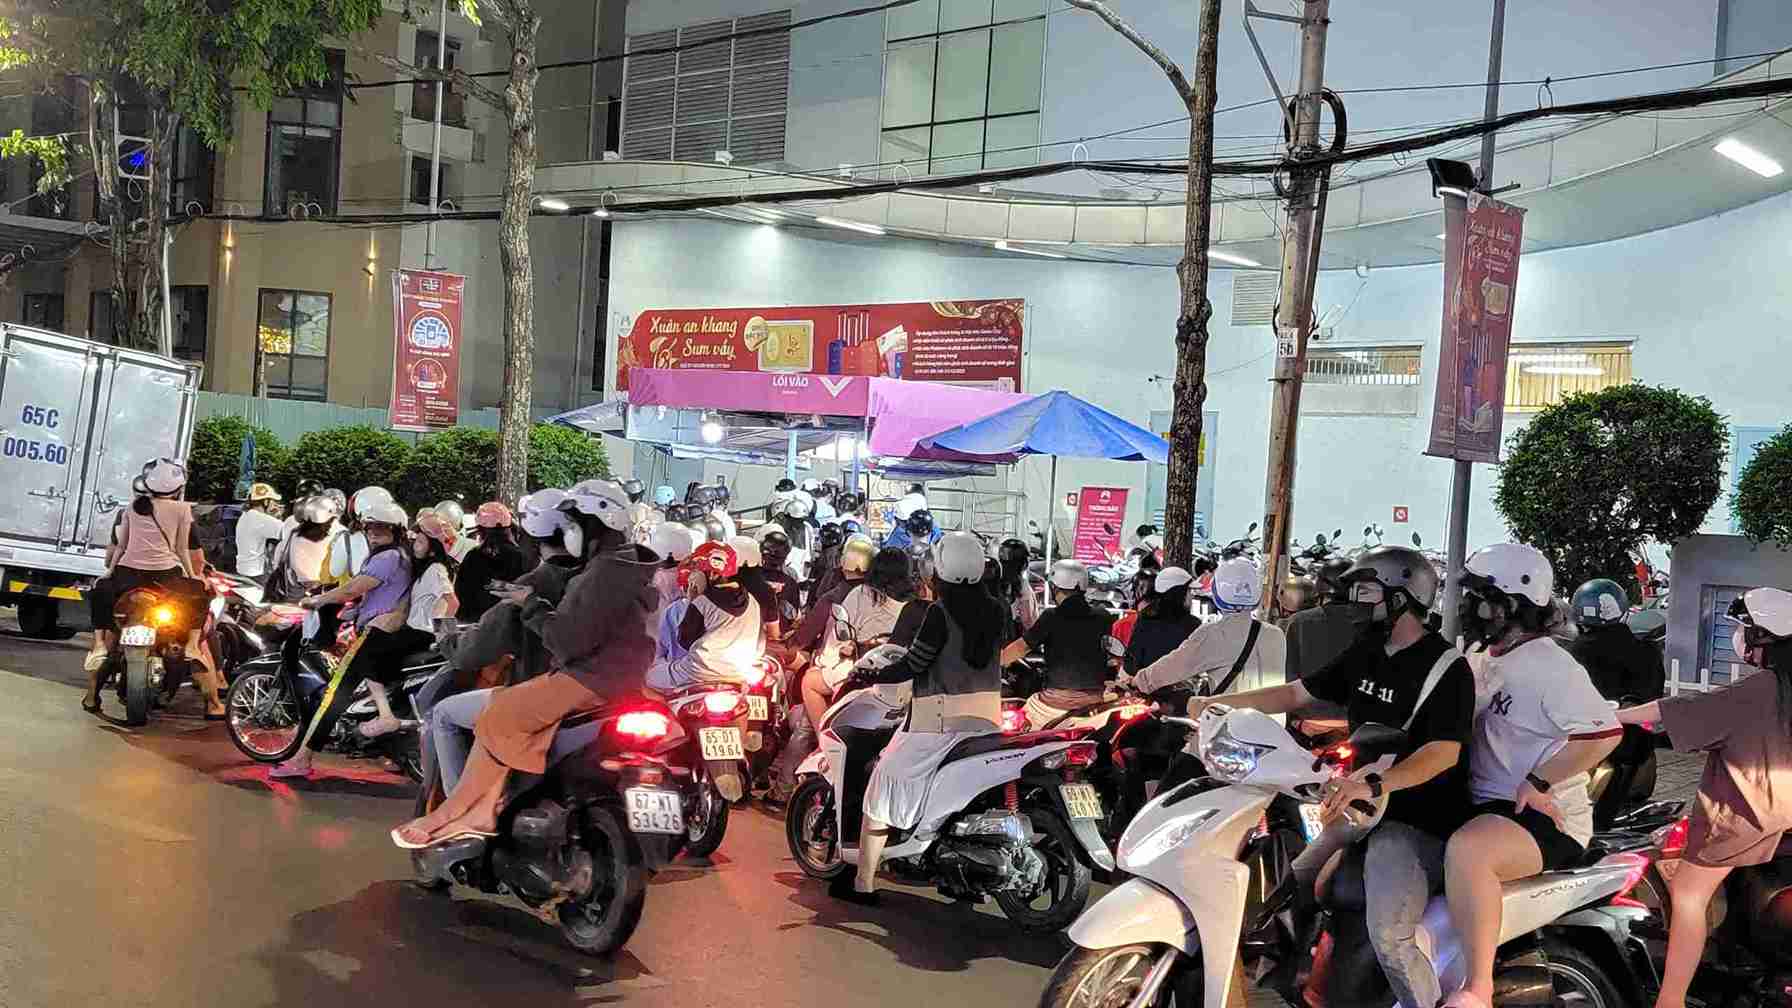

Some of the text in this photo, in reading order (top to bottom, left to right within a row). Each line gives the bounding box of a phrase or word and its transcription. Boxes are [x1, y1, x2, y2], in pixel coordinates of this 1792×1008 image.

[650, 316, 681, 333] Xuân
[683, 322, 699, 333] an
[701, 315, 738, 338] khang
[682, 337, 711, 357] Sum
[22, 405, 58, 428] 65C
[4, 437, 67, 465] 005.60
